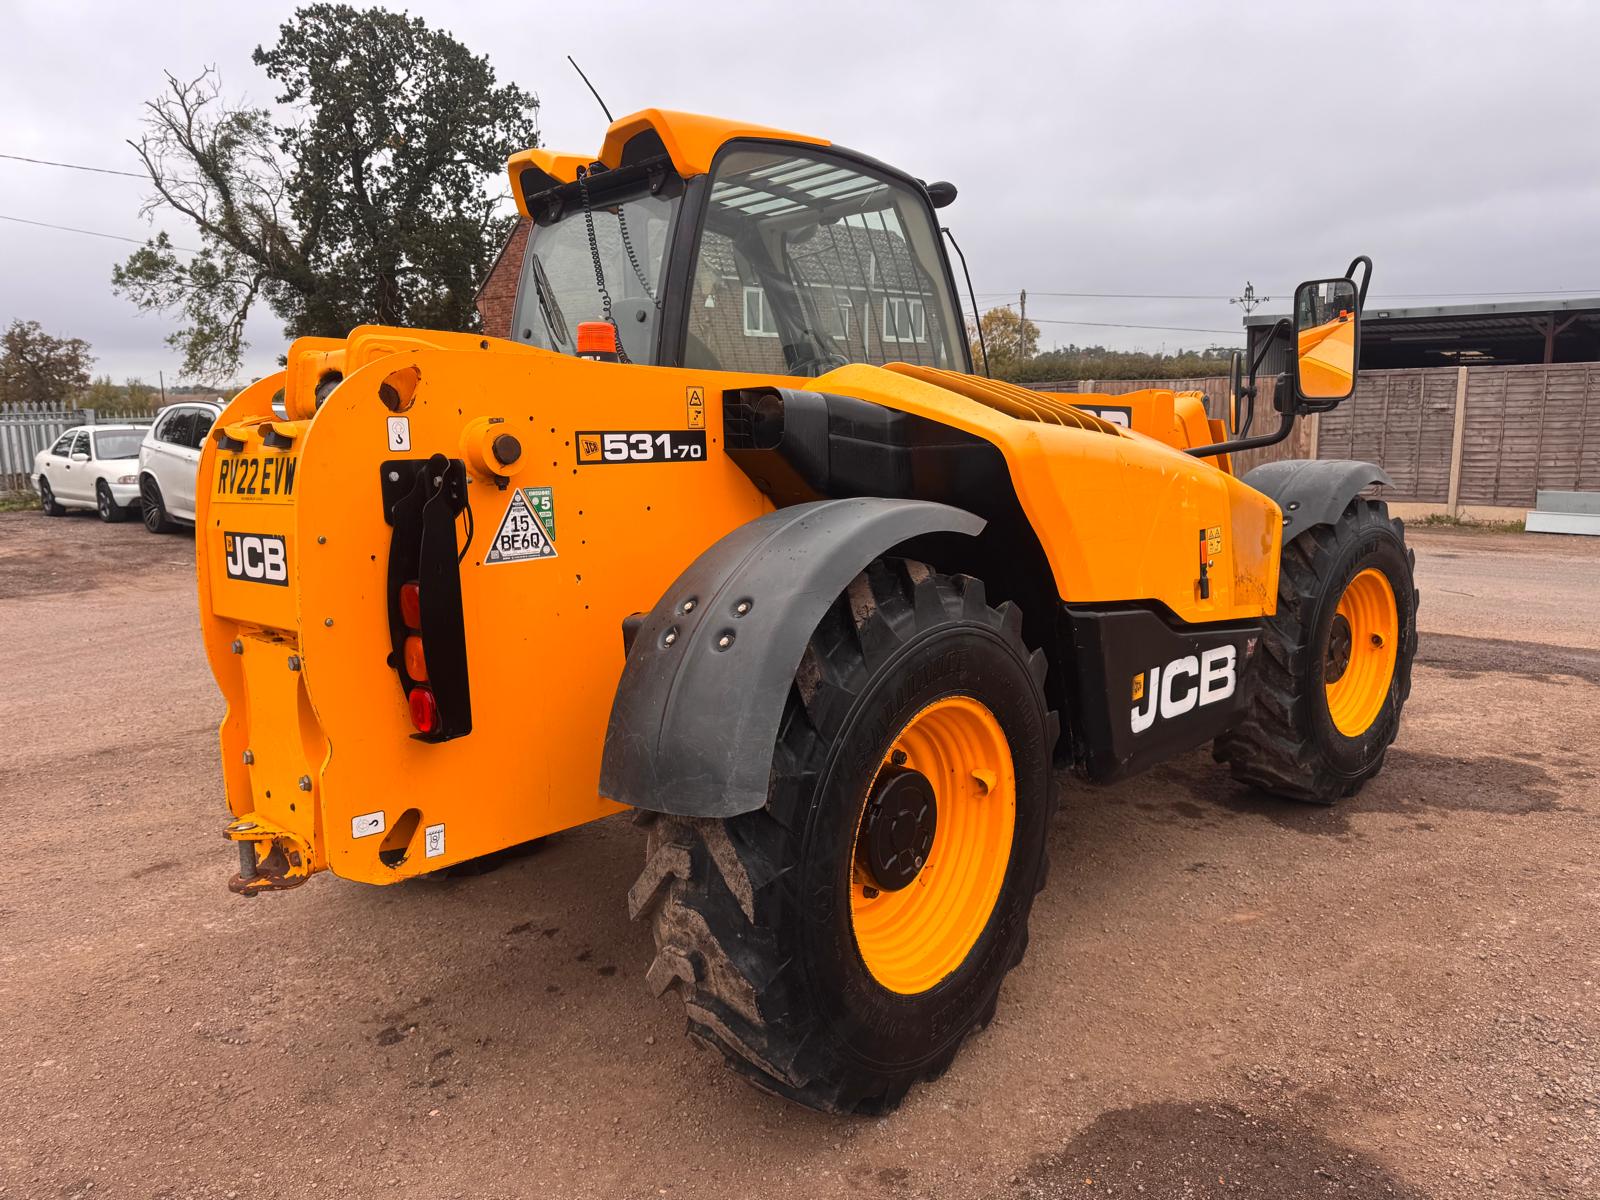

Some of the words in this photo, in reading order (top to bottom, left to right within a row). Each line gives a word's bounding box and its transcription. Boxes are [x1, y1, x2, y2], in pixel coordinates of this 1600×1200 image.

[584, 441, 598, 454] JCB
[604, 433, 702, 461] 531-70
[218, 458, 259, 495] RV22
[260, 457, 297, 495] EVW
[541, 496, 551, 510] 5
[511, 514, 529, 533] 15
[501, 533, 540, 551] BE6Q
[227, 536, 287, 581] JCB
[1131, 644, 1236, 733] JCB
